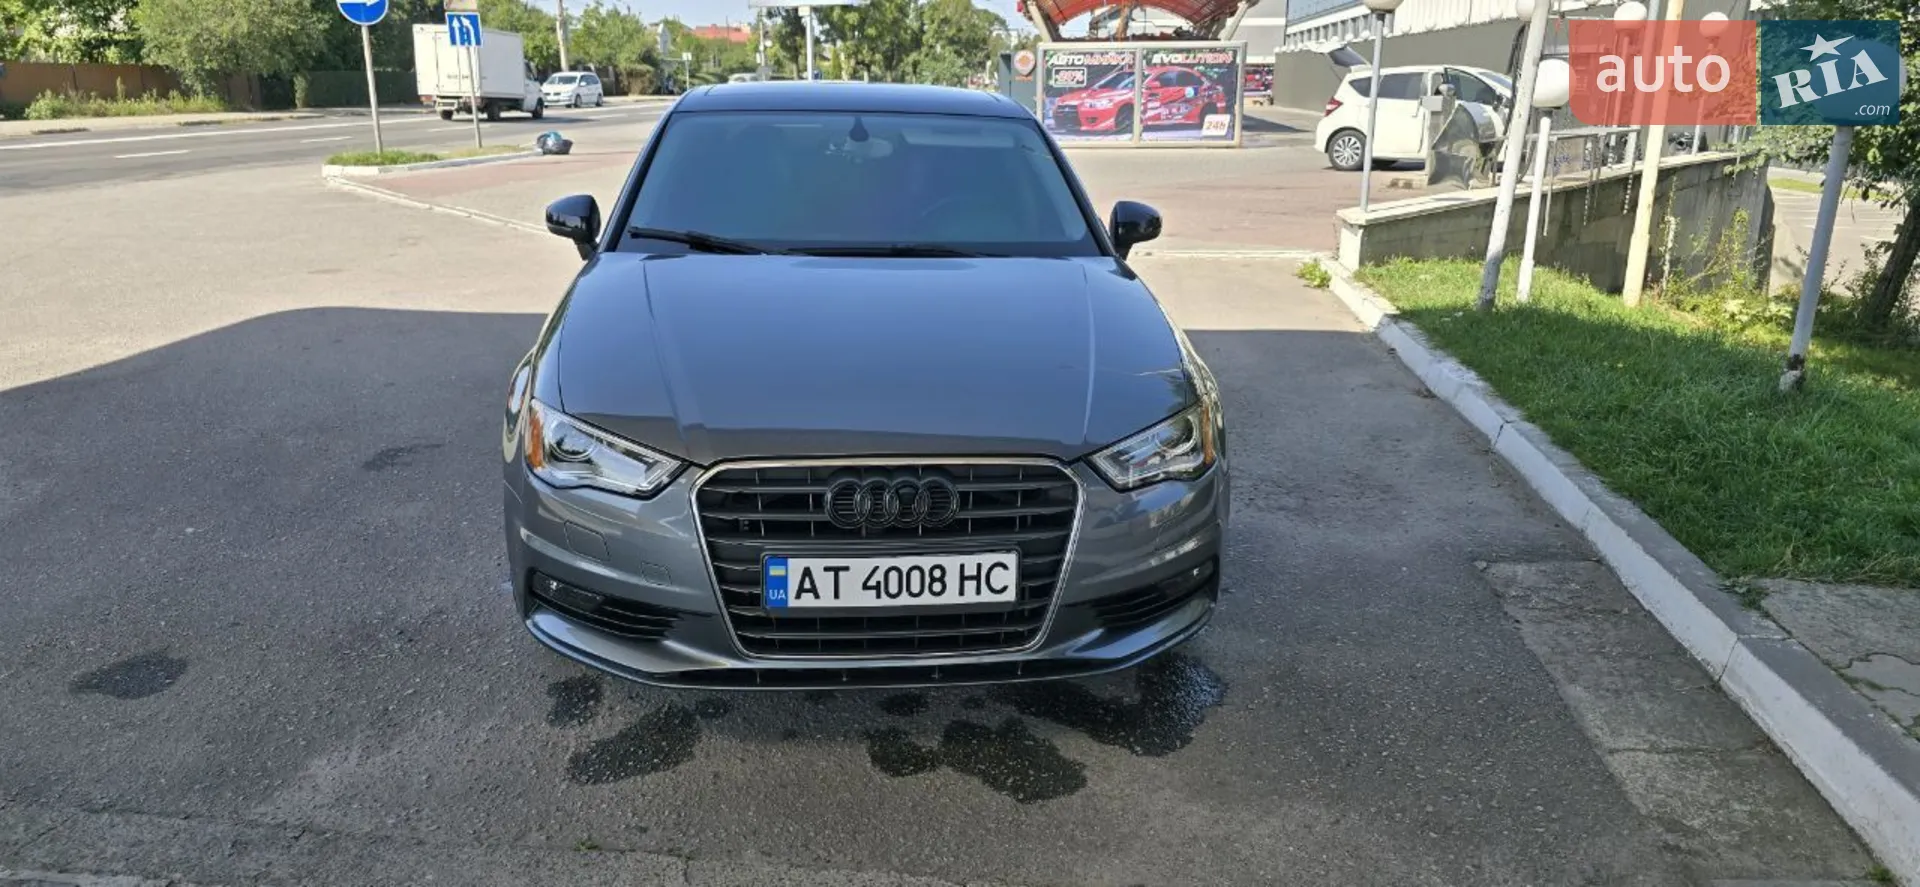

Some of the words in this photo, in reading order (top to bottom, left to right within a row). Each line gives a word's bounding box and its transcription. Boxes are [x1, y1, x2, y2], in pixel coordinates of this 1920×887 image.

[1151, 52, 1234, 64] EVOLUTION
[794, 565, 850, 600] AT
[861, 563, 947, 600] 4008
[958, 561, 1010, 597] HC
[769, 589, 786, 600] UA
